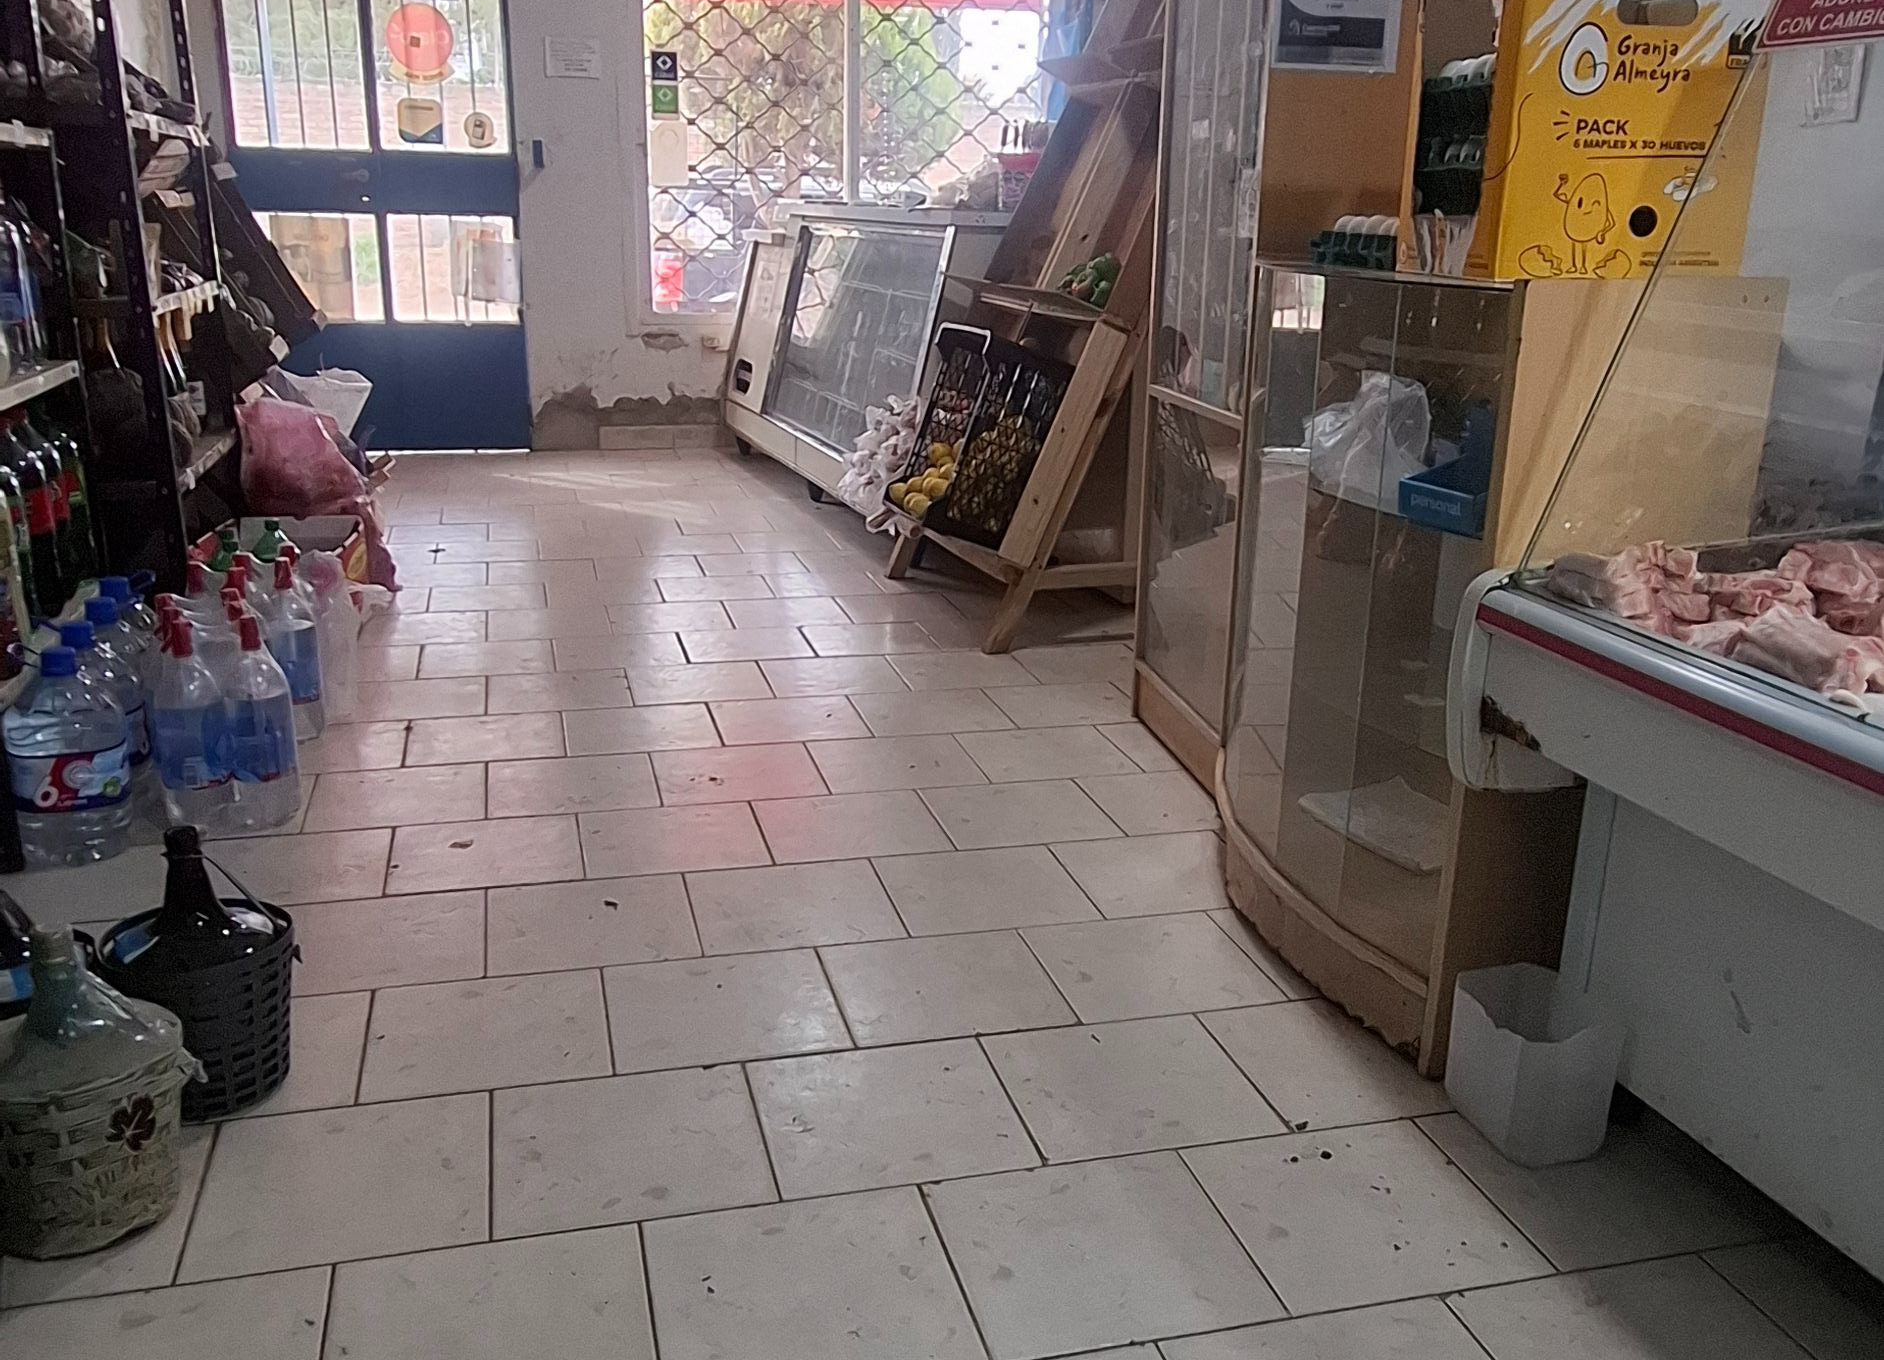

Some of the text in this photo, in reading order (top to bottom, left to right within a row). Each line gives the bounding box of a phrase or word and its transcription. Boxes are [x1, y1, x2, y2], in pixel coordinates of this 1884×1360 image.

[1777, 15, 1818, 36] CON
[1617, 34, 1679, 68] Granja
[1613, 59, 1691, 94] Almeyra
[1576, 119, 1630, 136] PACK
[1573, 139, 1707, 151] 6 MAPLES X 30 HUEVOS
[1410, 493, 1462, 517] personal
